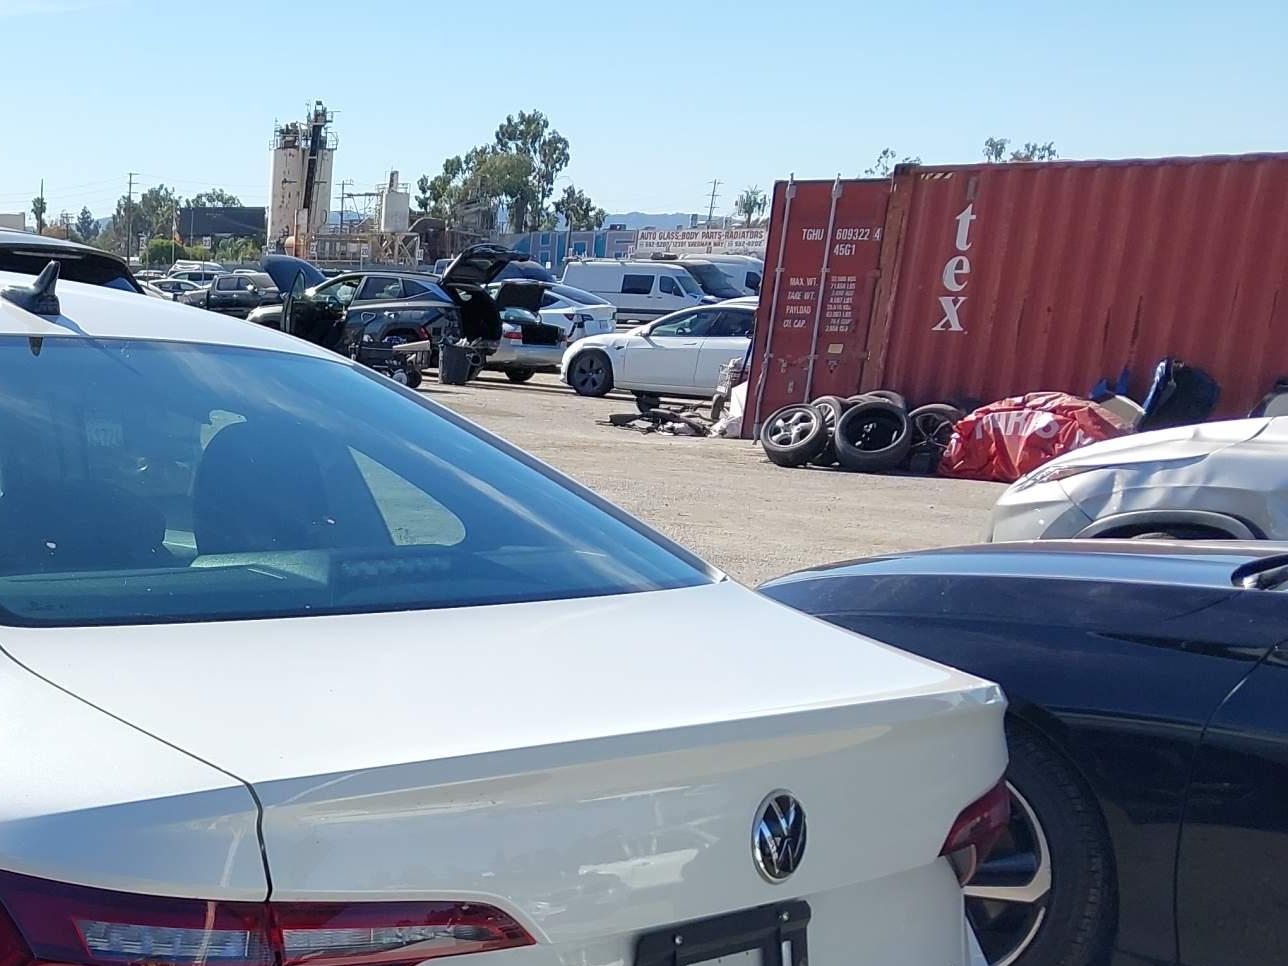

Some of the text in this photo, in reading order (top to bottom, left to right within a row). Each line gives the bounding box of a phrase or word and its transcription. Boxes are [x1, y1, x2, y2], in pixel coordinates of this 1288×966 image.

[640, 231, 657, 240] AUTO
[801, 228, 824, 241] TGHU
[836, 228, 870, 241] 609322
[833, 244, 856, 256] 45G1
[931, 203, 976, 333] tex
